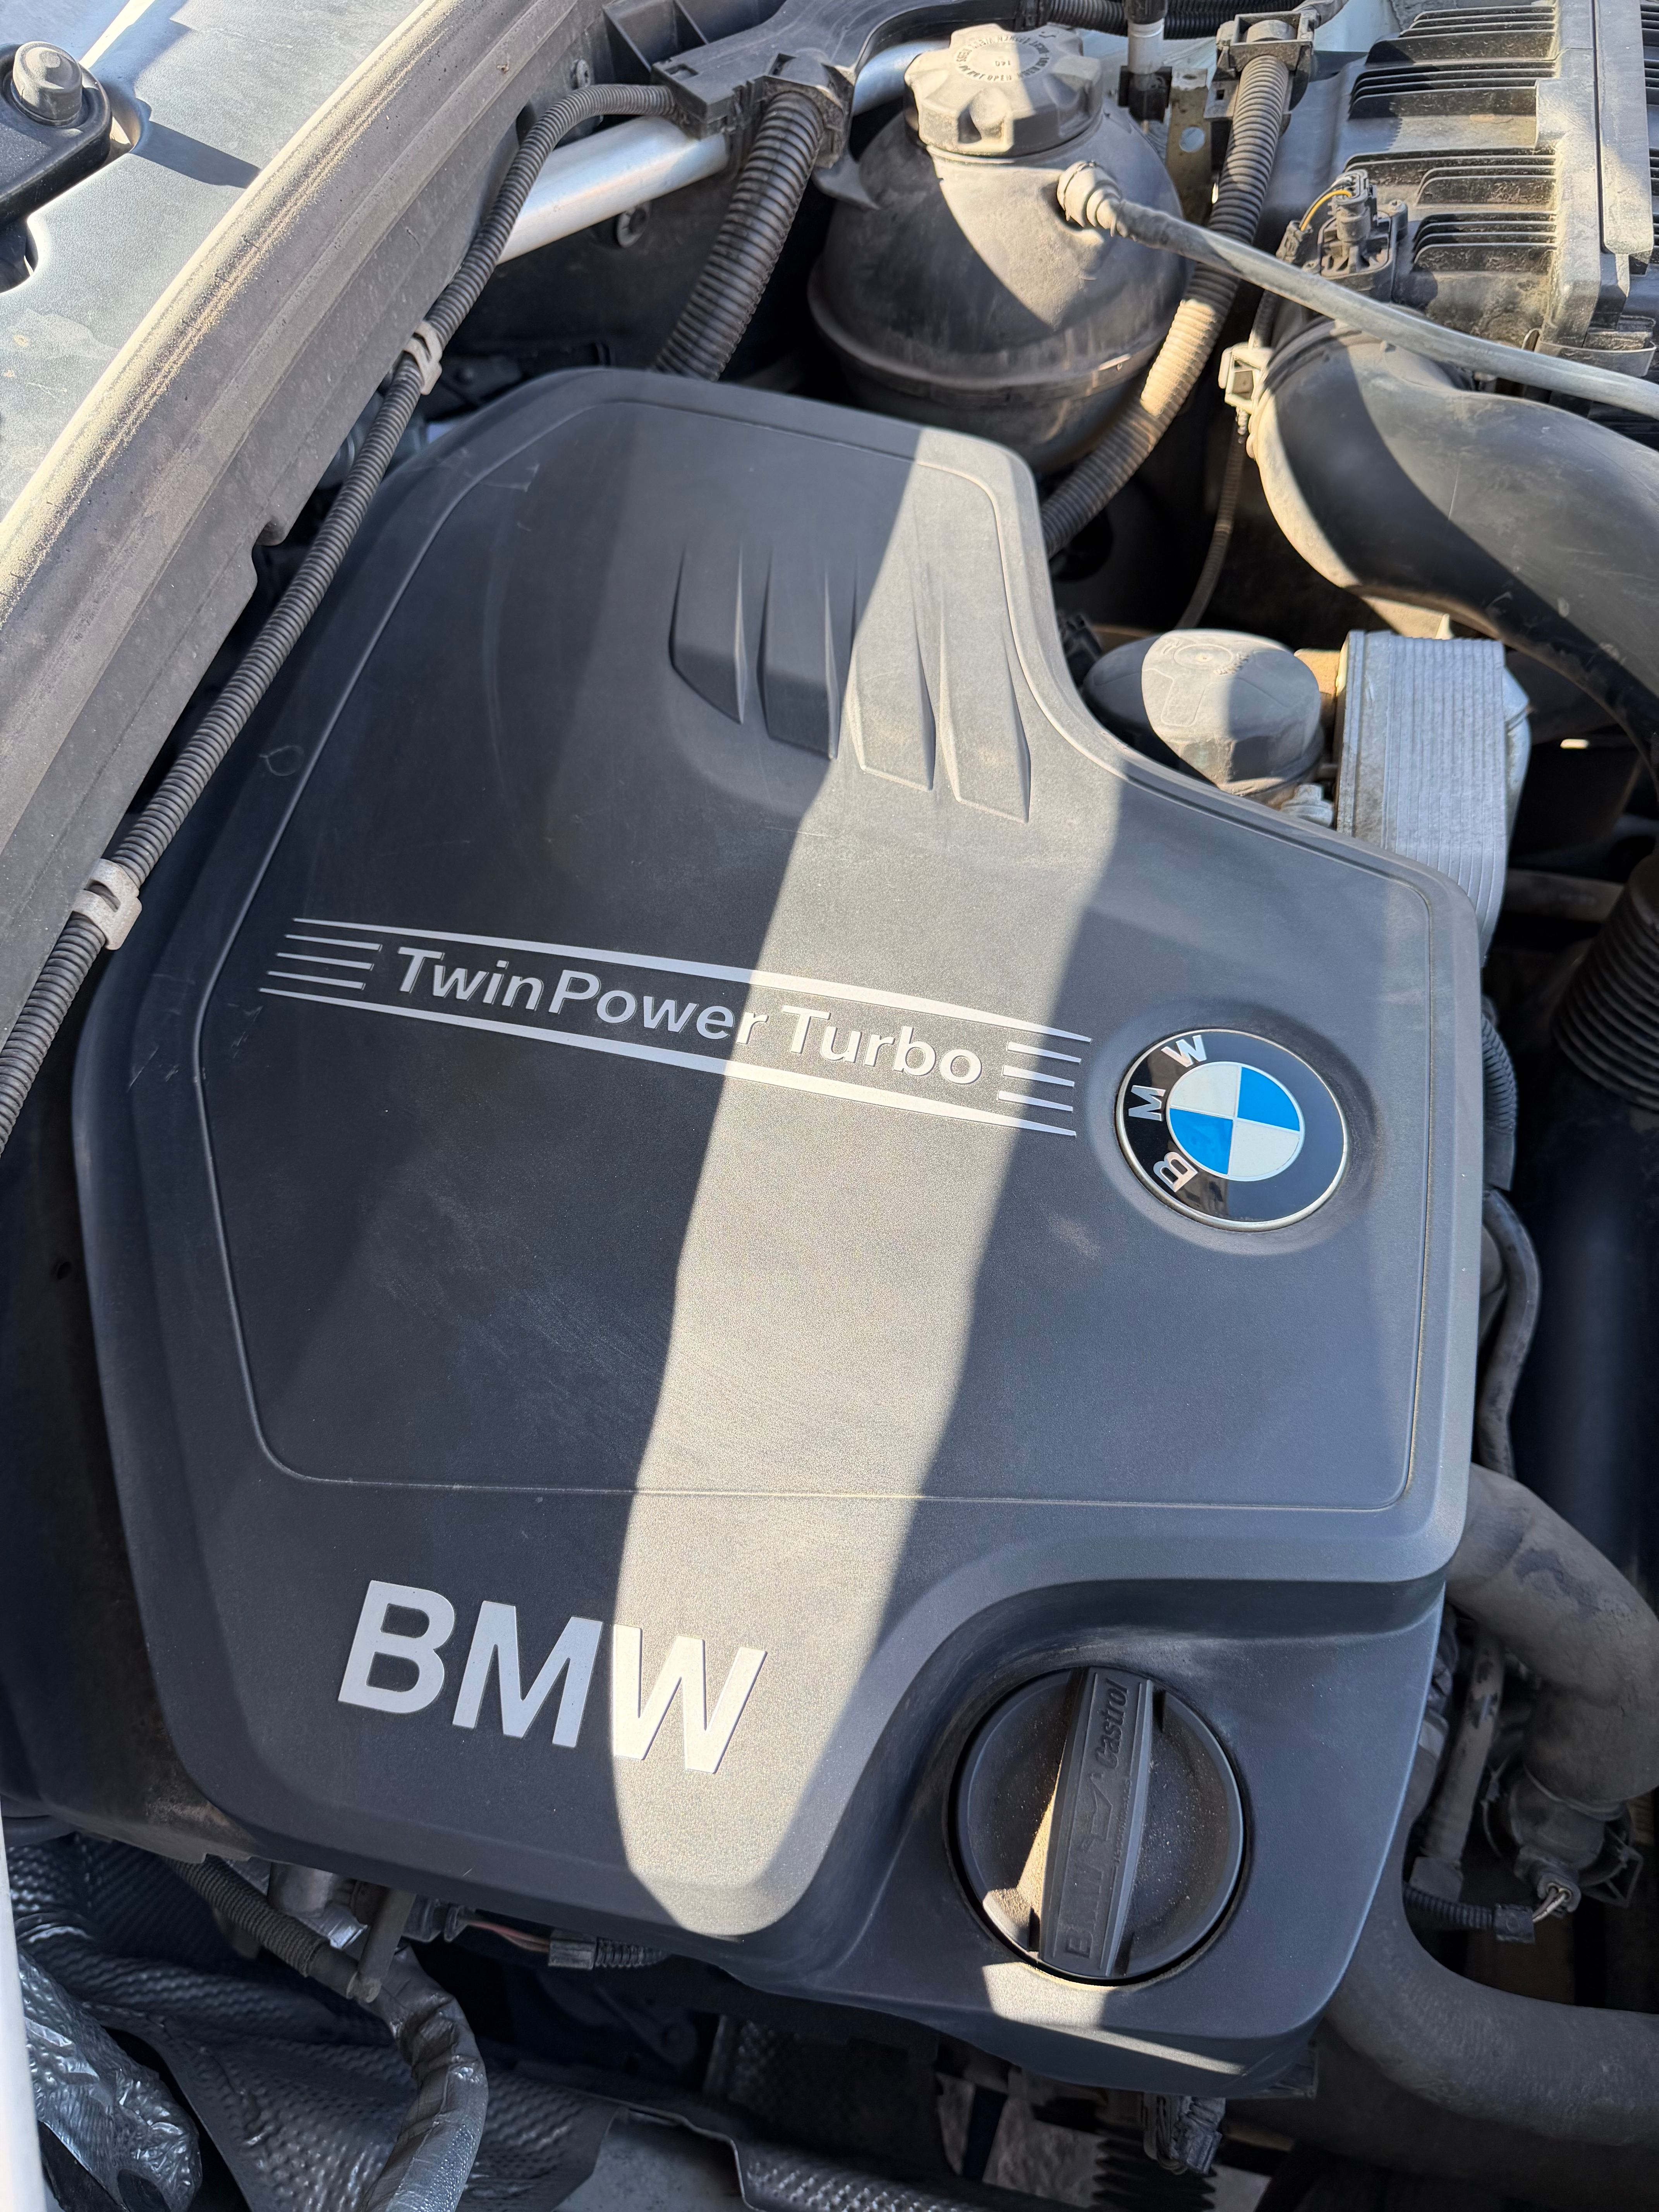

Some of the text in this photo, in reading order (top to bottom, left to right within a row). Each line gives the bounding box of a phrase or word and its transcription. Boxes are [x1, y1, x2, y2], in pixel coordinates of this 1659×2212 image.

[397, 946, 982, 1084] TwinPower Turbo
[1128, 1035, 1207, 1192] BMW
[337, 1580, 768, 1774] BMW
[1094, 1678, 1129, 1771] Castrol
